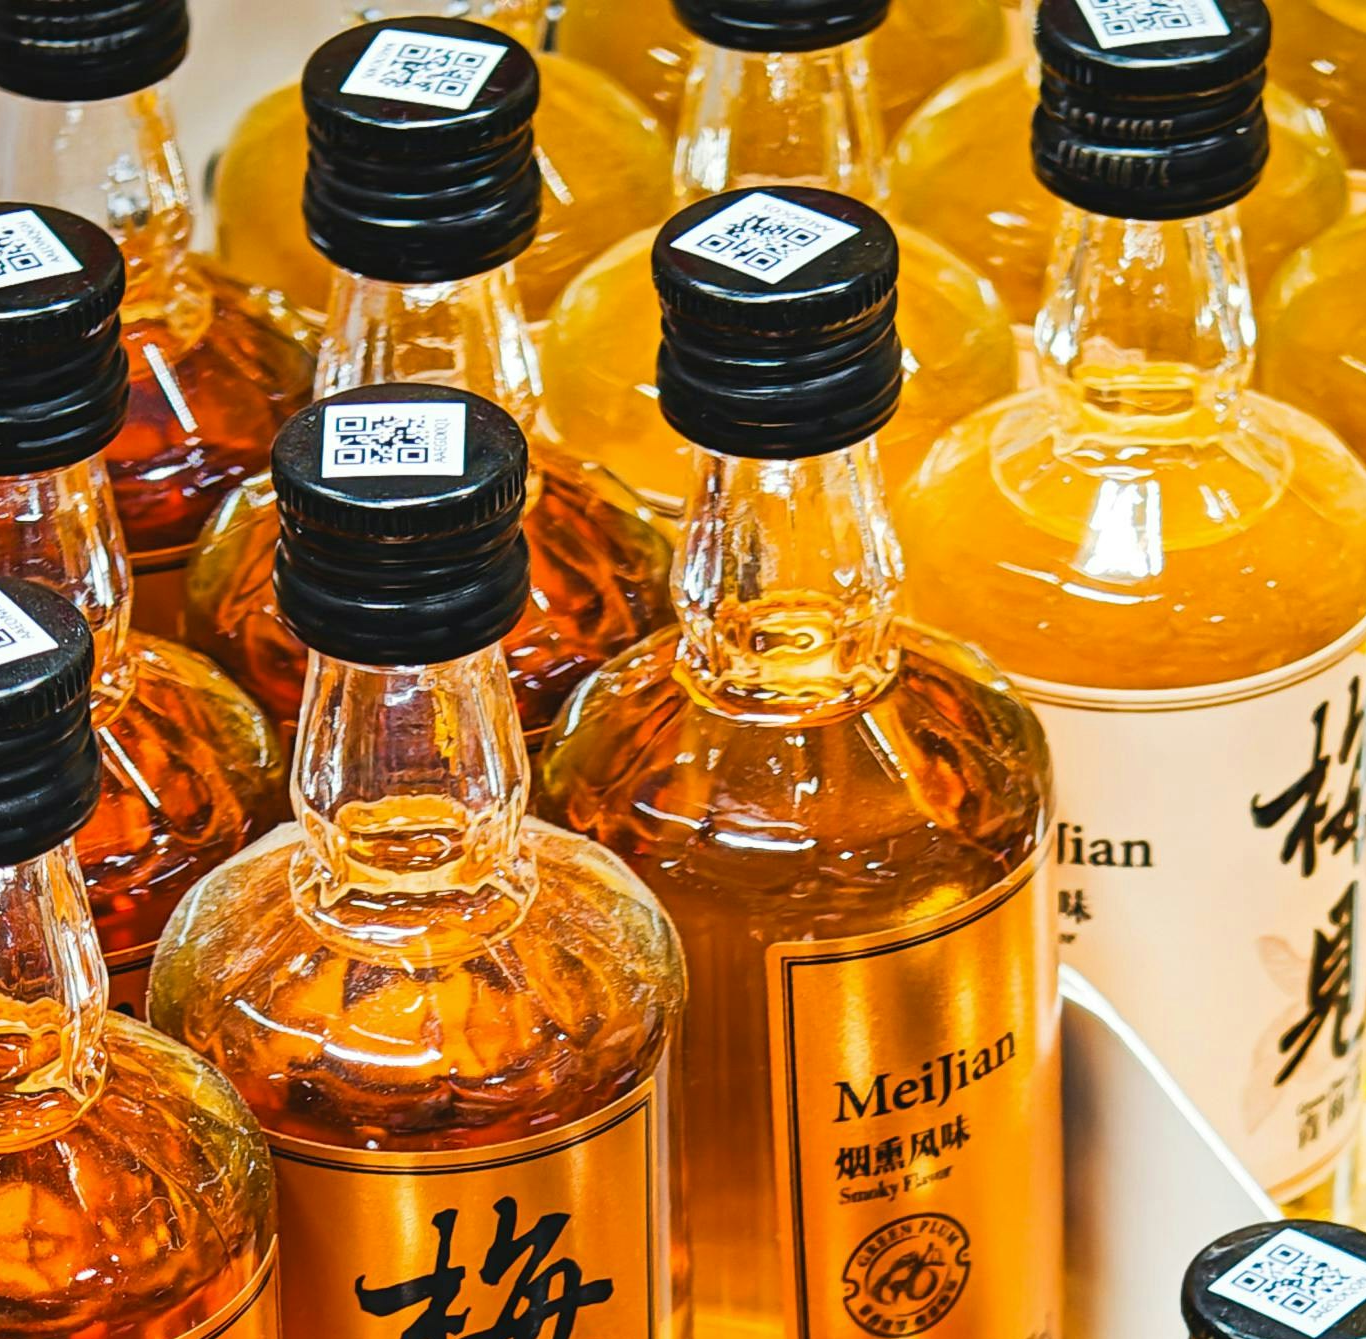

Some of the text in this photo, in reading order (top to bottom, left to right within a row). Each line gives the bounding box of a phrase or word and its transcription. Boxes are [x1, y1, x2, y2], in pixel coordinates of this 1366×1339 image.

[834, 1031, 1016, 1123] MeiJian
[835, 1114, 970, 1180] 烟熏风味
